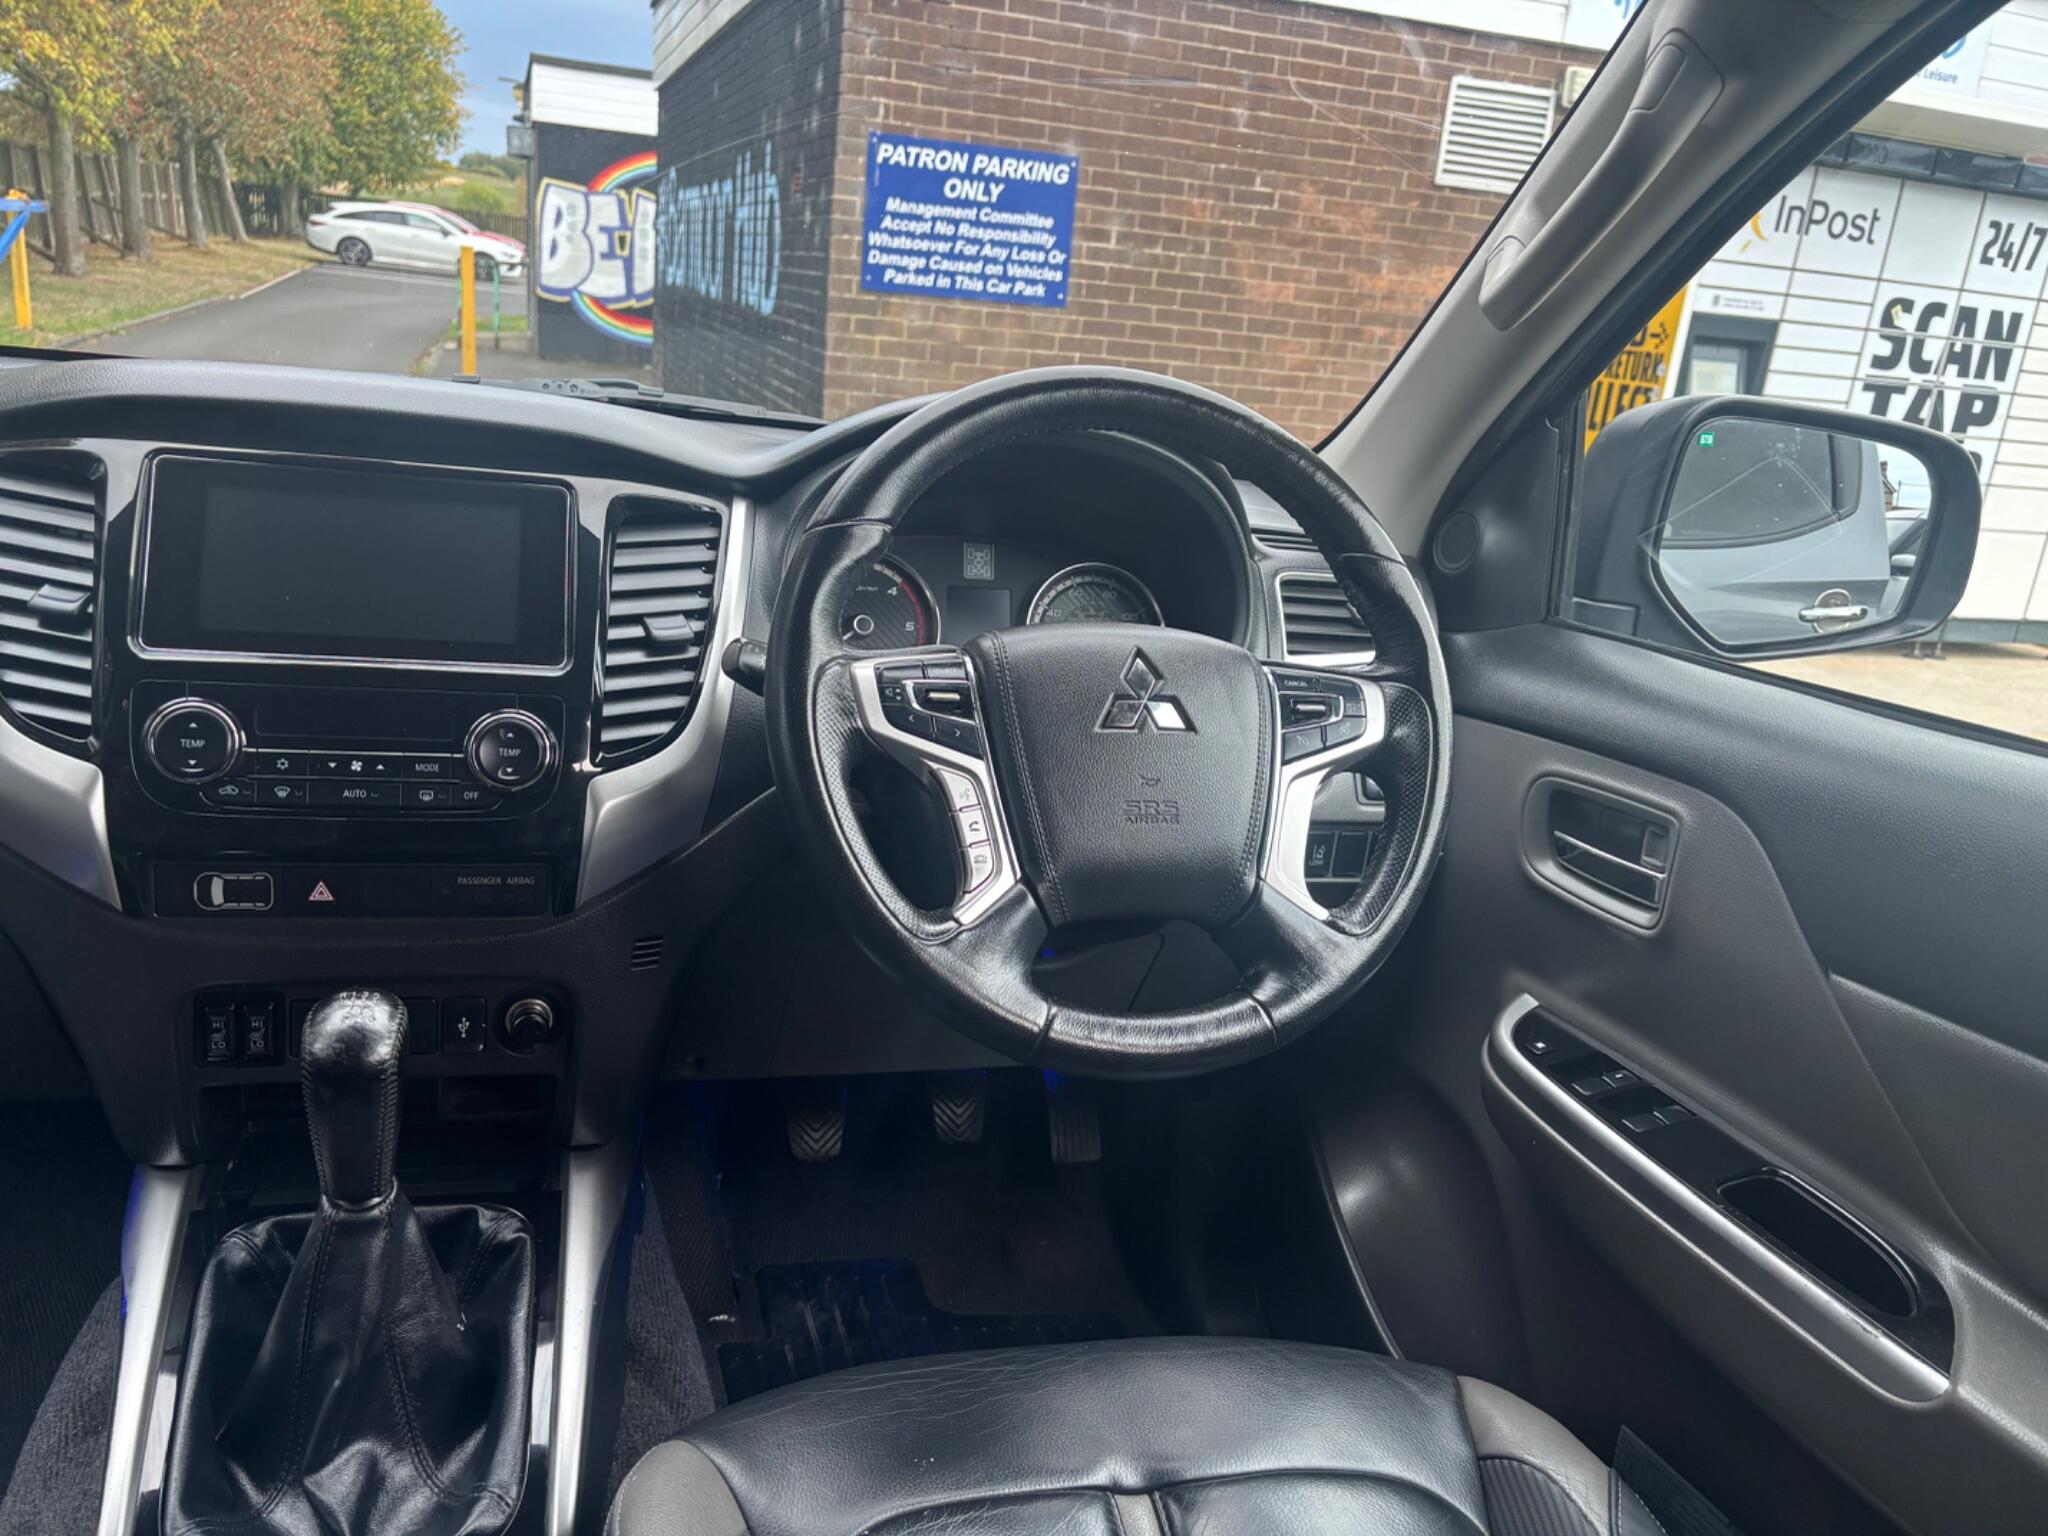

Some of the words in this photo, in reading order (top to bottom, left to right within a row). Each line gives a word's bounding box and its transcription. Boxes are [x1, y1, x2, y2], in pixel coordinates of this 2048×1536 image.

[1923, 67, 1959, 84] Leisure
[876, 142, 969, 173] PATRON
[972, 153, 1070, 185] PARKING
[943, 177, 1005, 204] ONLY
[885, 196, 978, 221] Management
[978, 206, 1055, 229] Committee
[1774, 195, 1880, 245] InPost
[732, 140, 782, 316] Hub
[880, 215, 933, 235] Accept
[934, 222, 955, 237] No
[957, 224, 1058, 249] Responsibility
[867, 231, 953, 254] Whatsoever
[954, 241, 980, 256] For
[980, 244, 1011, 262] Any
[1011, 247, 1046, 264] Loss
[1048, 250, 1068, 265] Or
[1979, 219, 2048, 273] 24/7
[867, 249, 928, 270] Damage
[928, 255, 984, 275] Caused
[984, 262, 1004, 276] on
[1006, 263, 1063, 282] Vehicles
[883, 268, 935, 287] Parked
[953, 275, 984, 292] This
[986, 278, 1012, 294] Car
[1012, 280, 1047, 298] Park
[1870, 297, 2023, 382] SCAN
[1862, 374, 2000, 435] TAP
[905, 621, 916, 632] 5
[180, 738, 206, 749] TEMP
[499, 748, 522, 757] TEMP
[415, 763, 440, 773] MODE
[342, 789, 367, 799] AUTO
[464, 791, 480, 800] OFF
[1122, 800, 1180, 815] SRS
[457, 876, 502, 886] PASSENGER
[506, 876, 535, 886] AIRBAG
[212, 1021, 225, 1030] HI
[251, 1020, 263, 1029] HI
[212, 1041, 226, 1049] LO
[250, 1040, 264, 1048] LO
